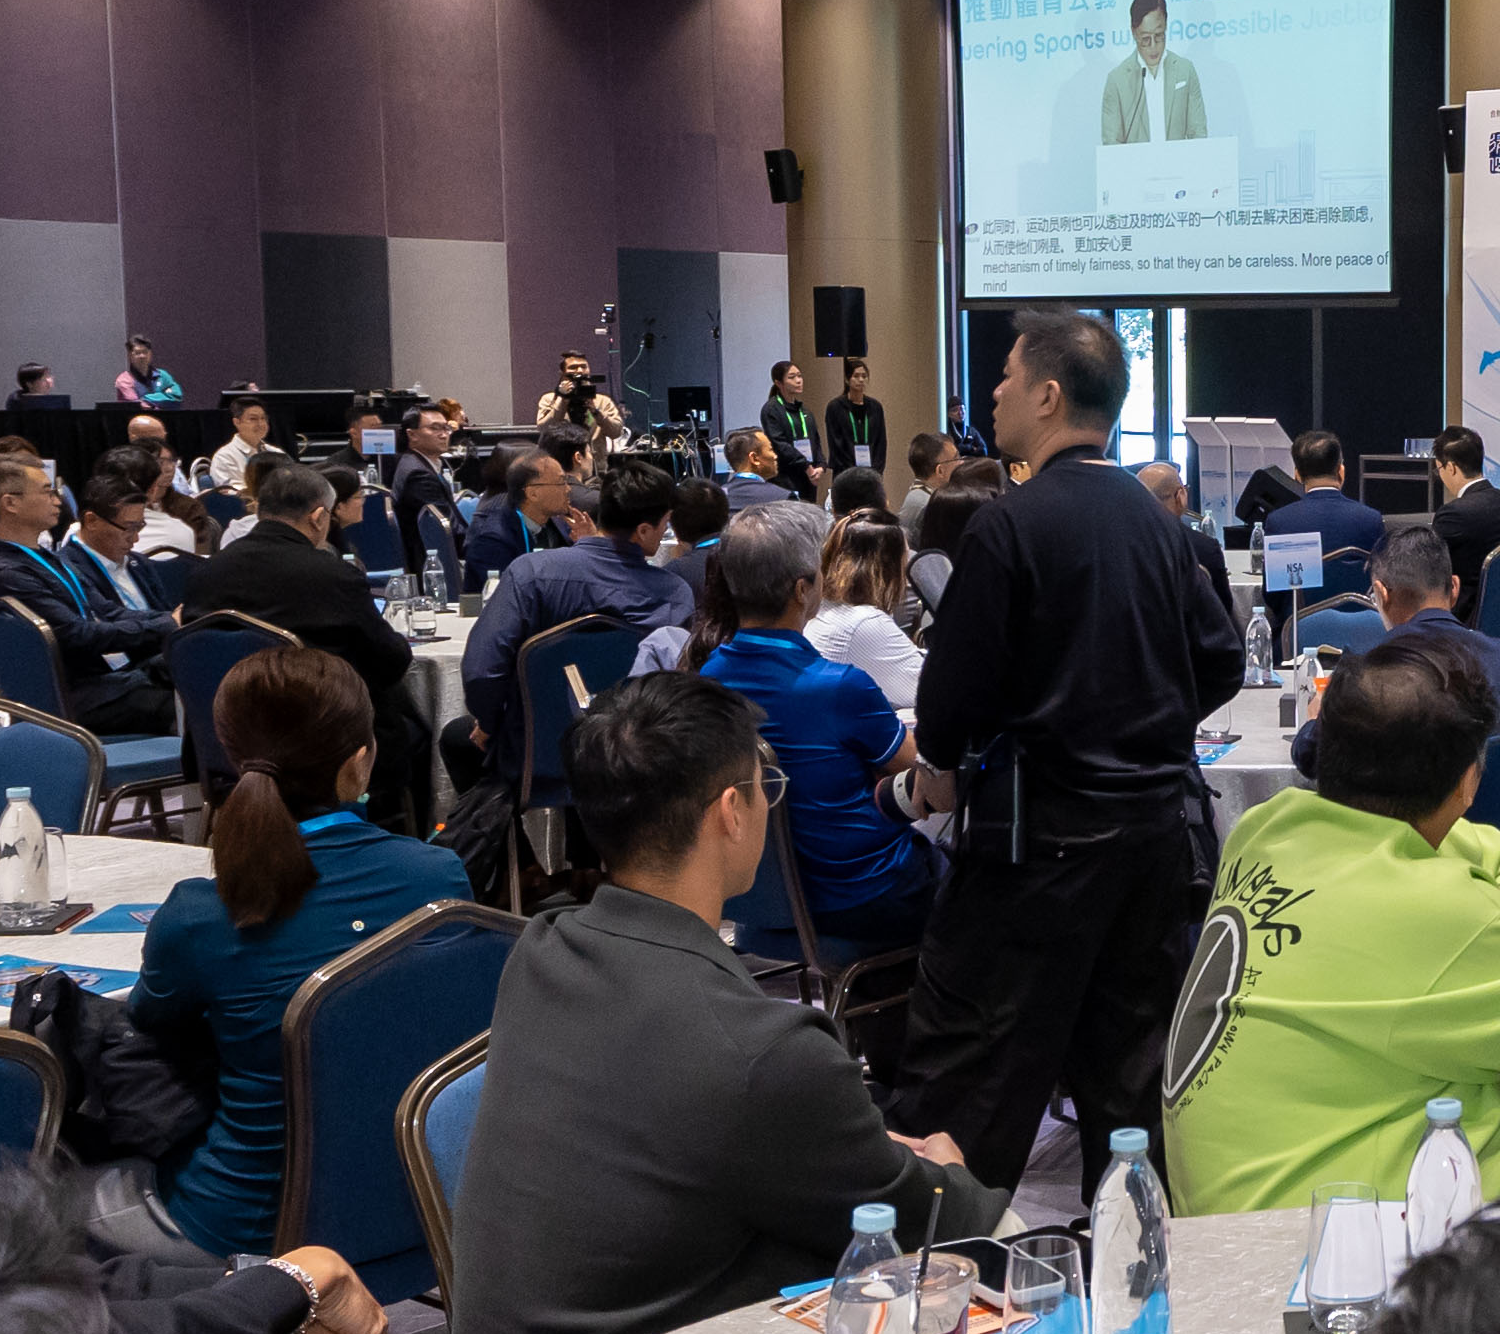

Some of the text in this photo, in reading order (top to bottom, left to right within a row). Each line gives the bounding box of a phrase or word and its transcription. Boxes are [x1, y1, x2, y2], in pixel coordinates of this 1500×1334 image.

[1033, 27, 1106, 59] Sports
[1168, 7, 1293, 44] Accessible
[983, 249, 1389, 275] mechanism of timely fairness, so that they can be careless. More peace of
[983, 278, 1008, 293] mind
[1286, 563, 1304, 573] NSA
